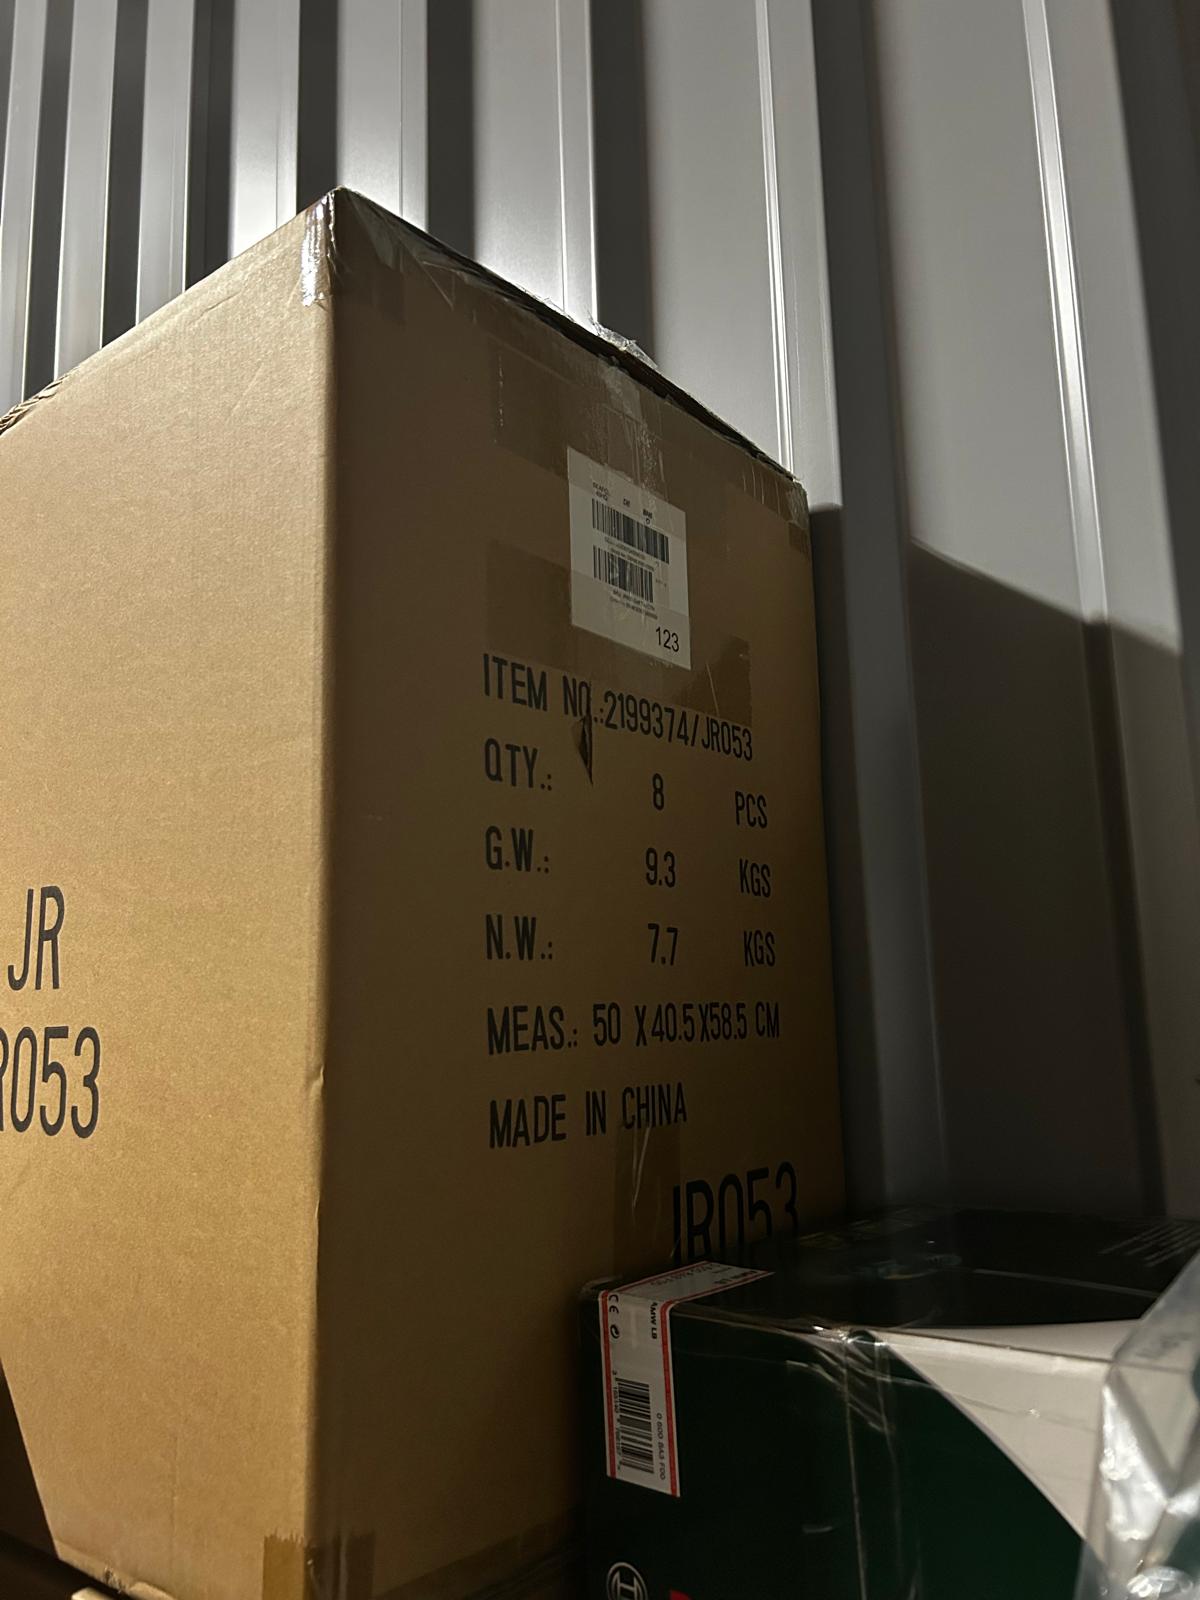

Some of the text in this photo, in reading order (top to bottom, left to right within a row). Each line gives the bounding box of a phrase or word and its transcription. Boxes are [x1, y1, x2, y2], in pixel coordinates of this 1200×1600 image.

[655, 625, 680, 653] 123
[483, 653, 547, 711] ITEM
[485, 738, 768, 828] QTY.: 8 PCS
[485, 825, 771, 898] G.W.: 9.3 KGS
[7, 885, 65, 991] JR
[485, 914, 776, 967] N.W.: 7.7 KGS
[487, 1003, 578, 1055] MEAS.:
[592, 1002, 622, 1047] 50
[755, 1001, 780, 1039] CM
[489, 1082, 687, 1148] MADE IN CHINA
